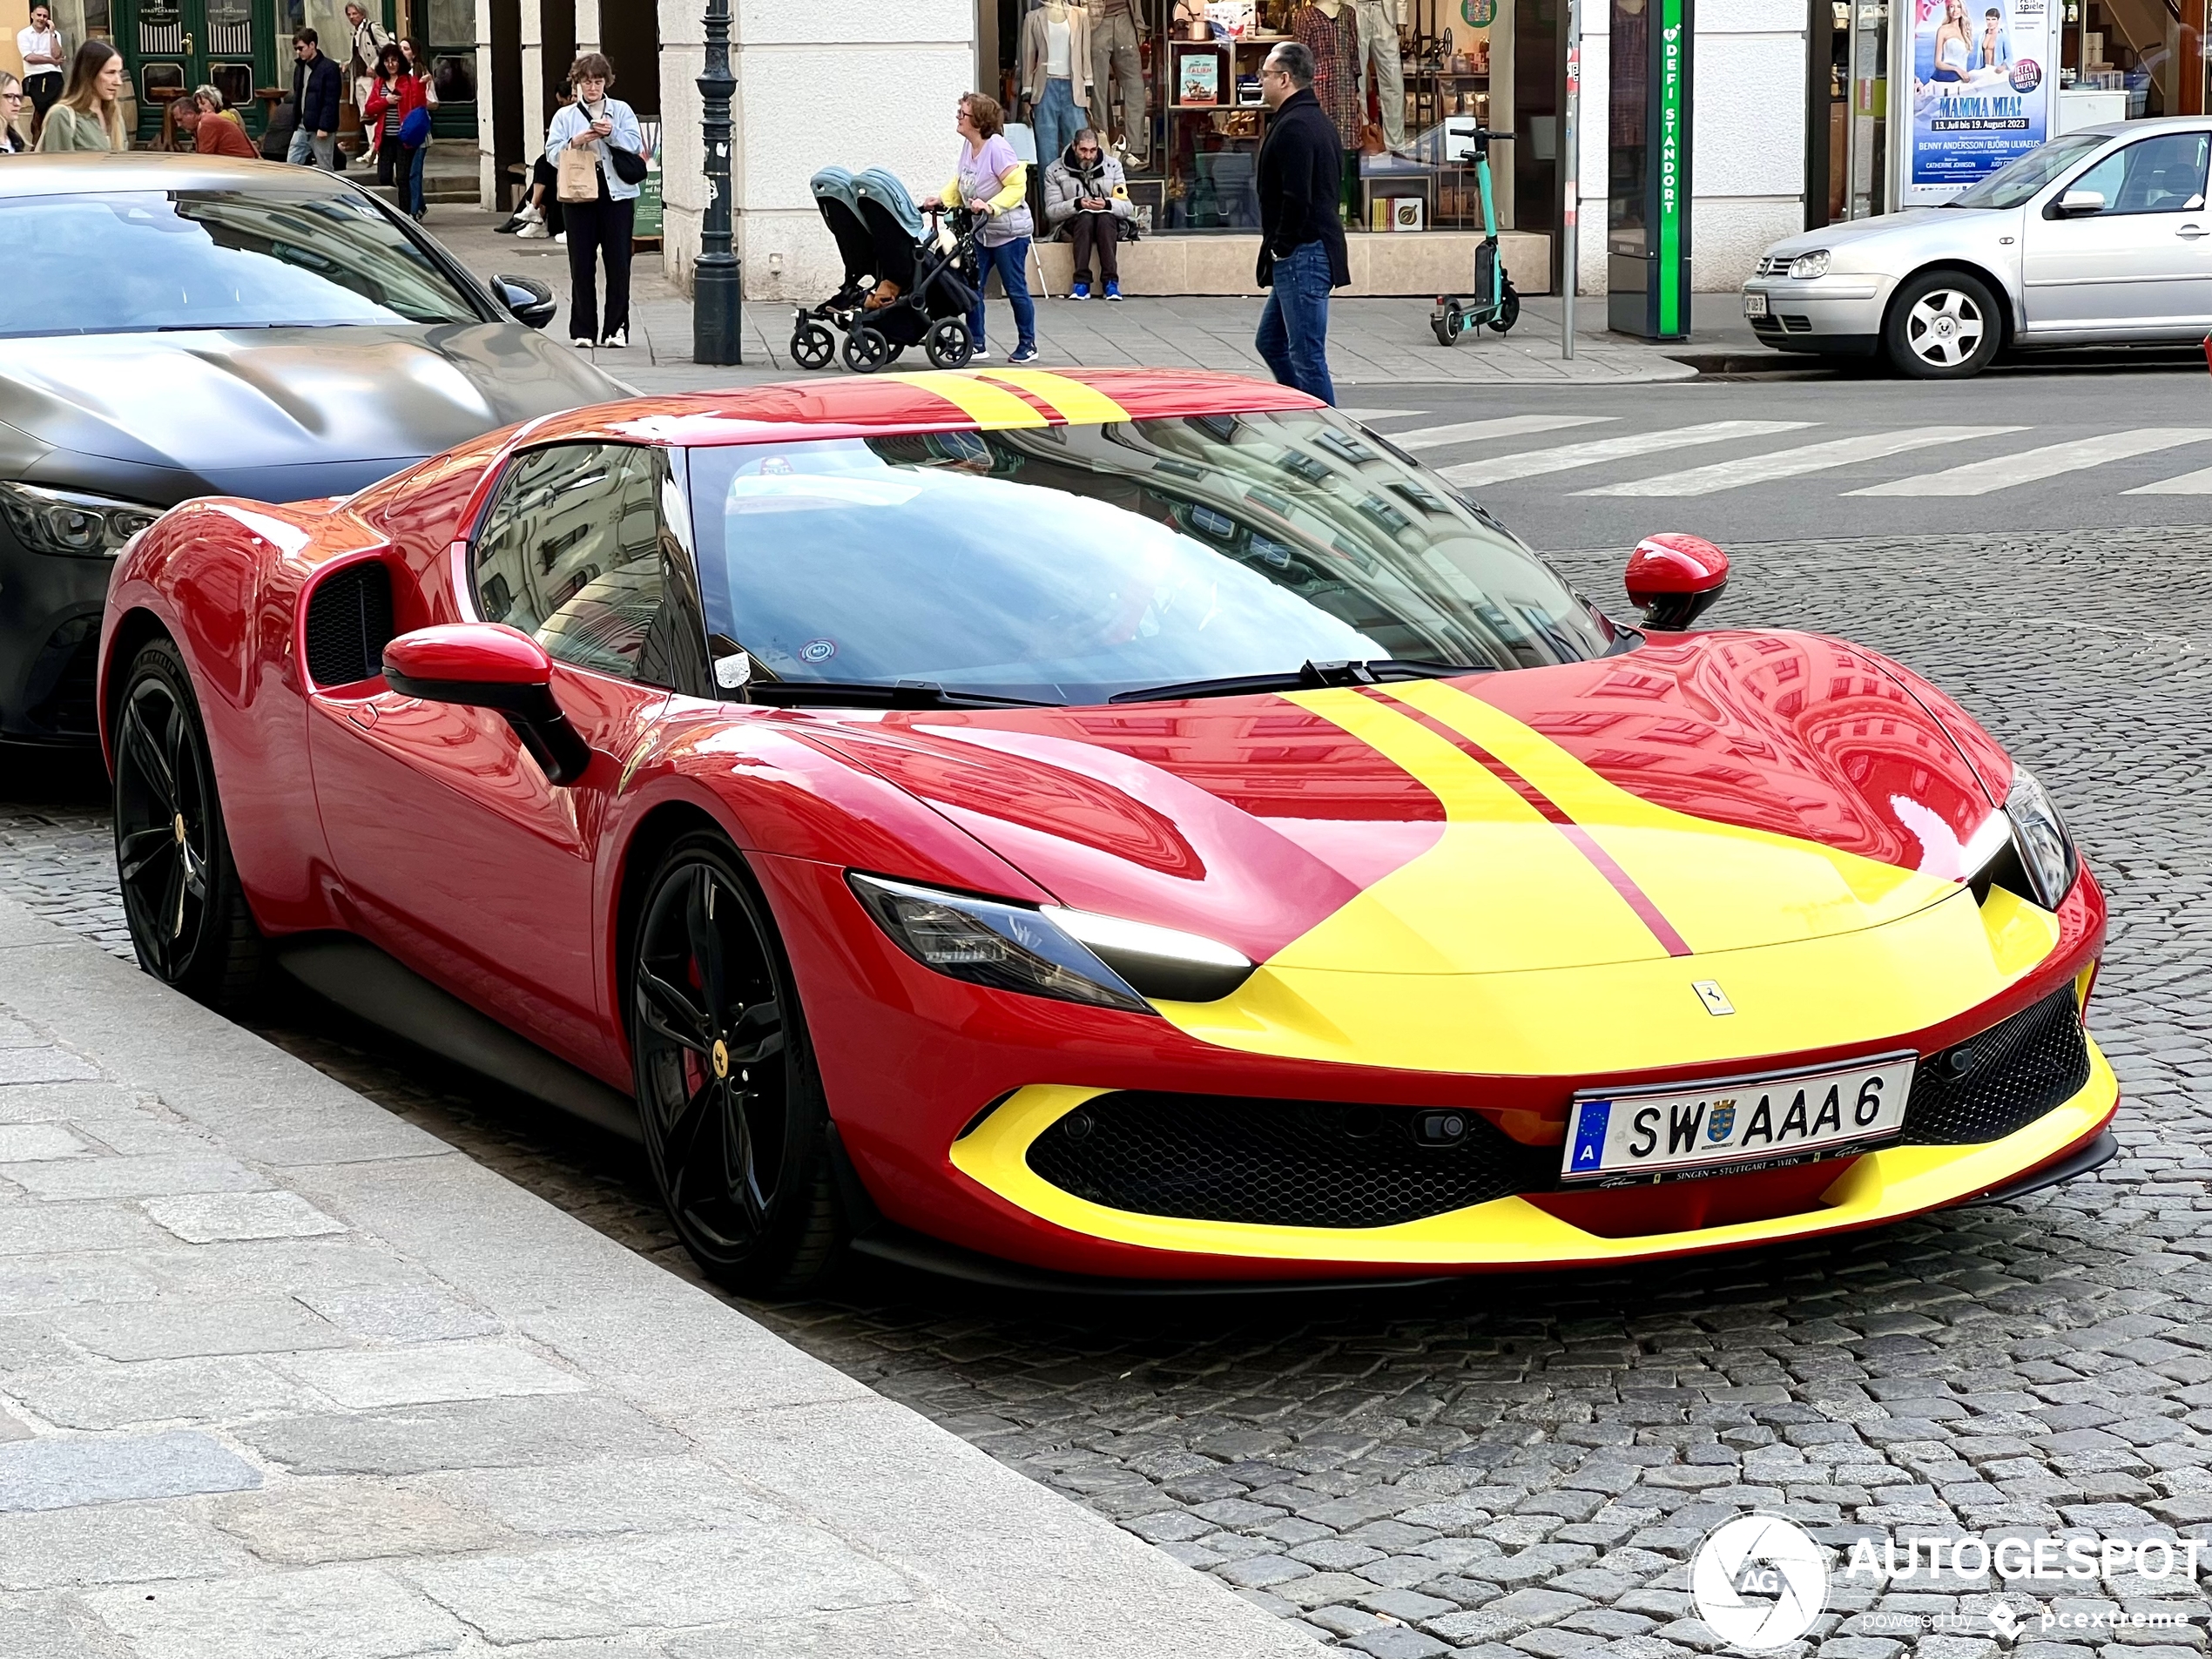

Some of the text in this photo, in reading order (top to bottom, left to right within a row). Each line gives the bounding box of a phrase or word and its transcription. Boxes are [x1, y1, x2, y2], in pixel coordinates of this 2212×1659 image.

[2020, 2, 2044, 12] spiele
[1939, 96, 2022, 118] MAMMA MIA!
[1662, 44, 1678, 213] DEFI STANDORT
[1935, 119, 2026, 130] 13. Juli bis 19. August 2023
[1629, 1074, 1885, 1158] SW AAA 6
[1580, 1144, 1595, 1162] A
[1676, 1170, 1709, 1181] SINGEN
[1719, 1162, 1768, 1176] STUTTGART
[1777, 1157, 1799, 1167] WIEN
